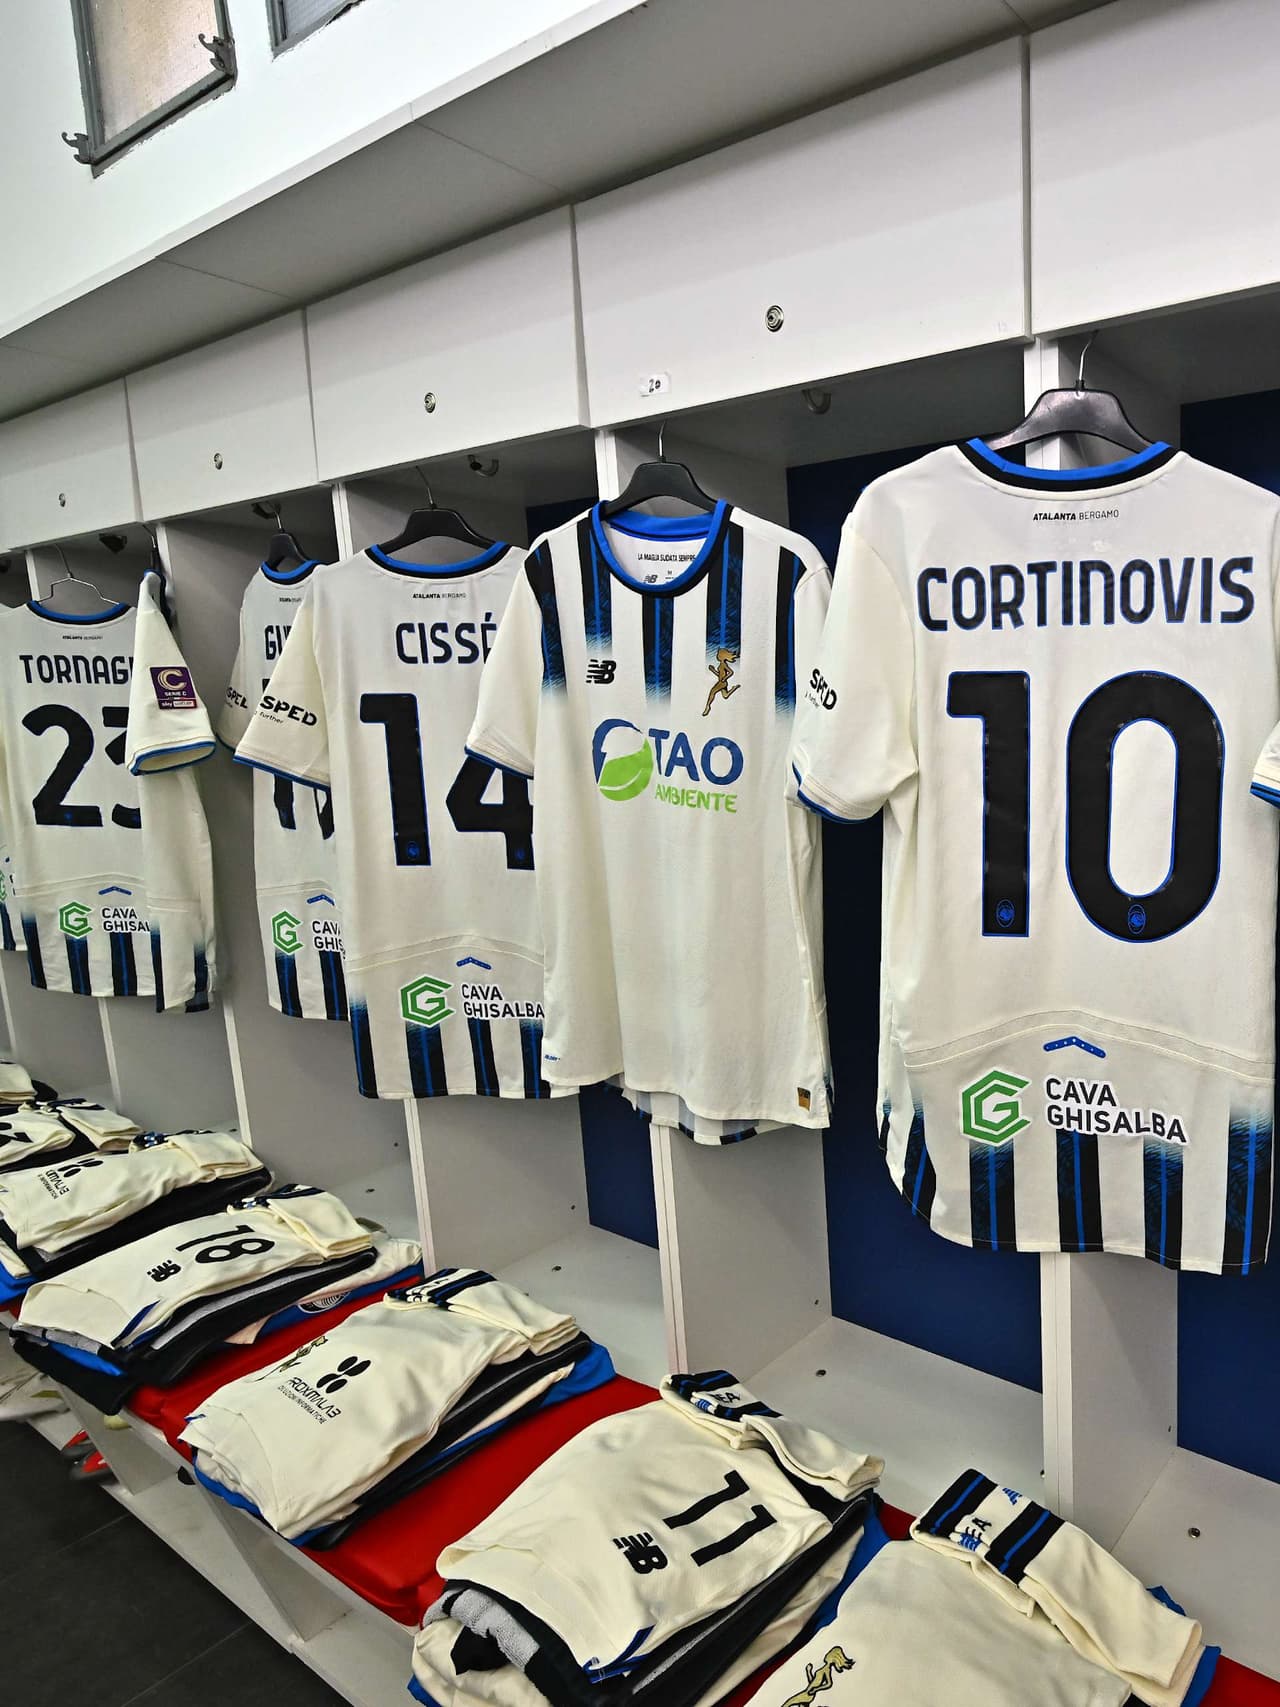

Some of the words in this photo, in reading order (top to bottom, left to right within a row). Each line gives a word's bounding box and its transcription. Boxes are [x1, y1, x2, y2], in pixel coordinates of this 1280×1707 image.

[1032, 512, 1077, 521] ATALANTA
[1079, 509, 1120, 520] BERGAMO
[916, 556, 1255, 632] CORTINOVIS
[19, 654, 134, 684] TORNAG
[259, 695, 318, 726] SPED
[648, 728, 744, 786] TAO
[359, 692, 536, 870] 14
[655, 783, 738, 814] AMBIENTE
[946, 670, 1226, 944] 10
[102, 907, 138, 919] CAVA
[312, 920, 341, 935] CAV
[461, 983, 504, 1001] CAVA
[463, 1001, 545, 1019] GHISALBA
[1045, 1078, 1117, 1107] CAVA
[1046, 1104, 1188, 1143] GHISALBA
[176, 1224, 276, 1264] 18
